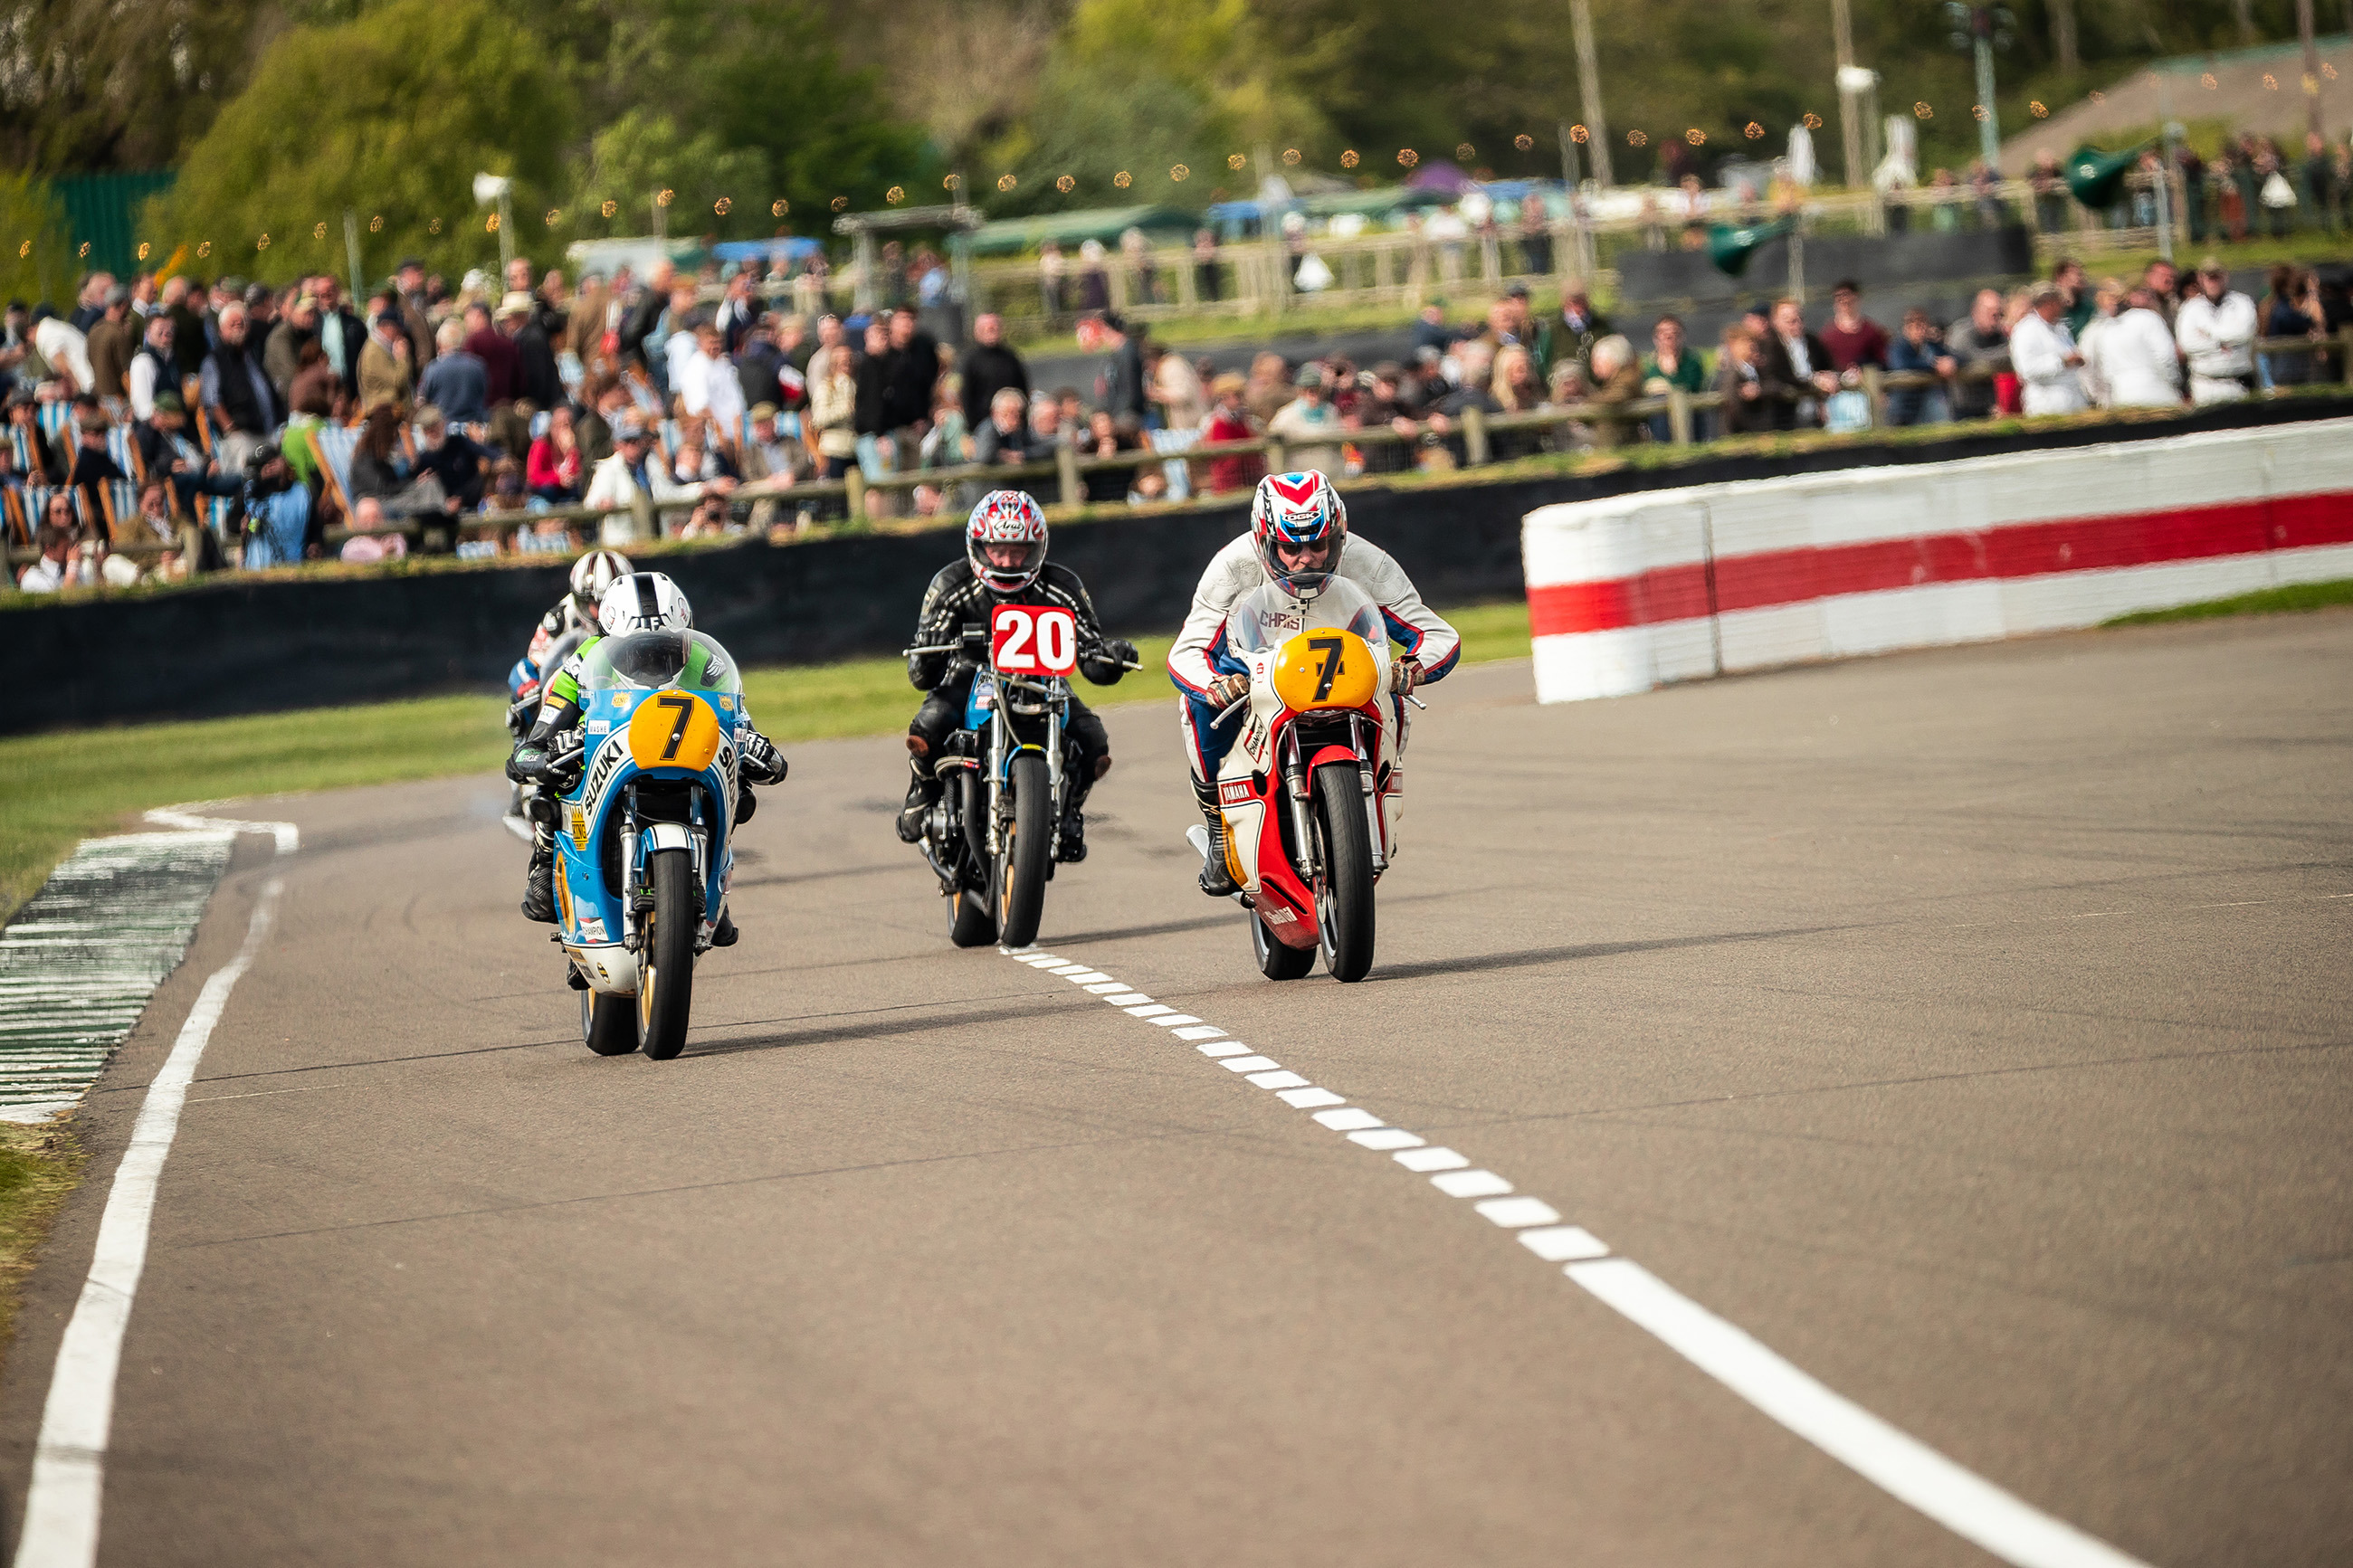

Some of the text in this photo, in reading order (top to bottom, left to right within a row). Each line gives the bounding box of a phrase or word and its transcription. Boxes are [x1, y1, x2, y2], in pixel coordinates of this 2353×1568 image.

[997, 520, 1021, 530] Arai
[1288, 512, 1317, 521] OGK
[996, 610, 1075, 670] 20
[1260, 609, 1300, 631] CHRIS
[1308, 636, 1346, 702] 7
[657, 696, 694, 761] 7
[585, 739, 624, 816] SUZUKI
